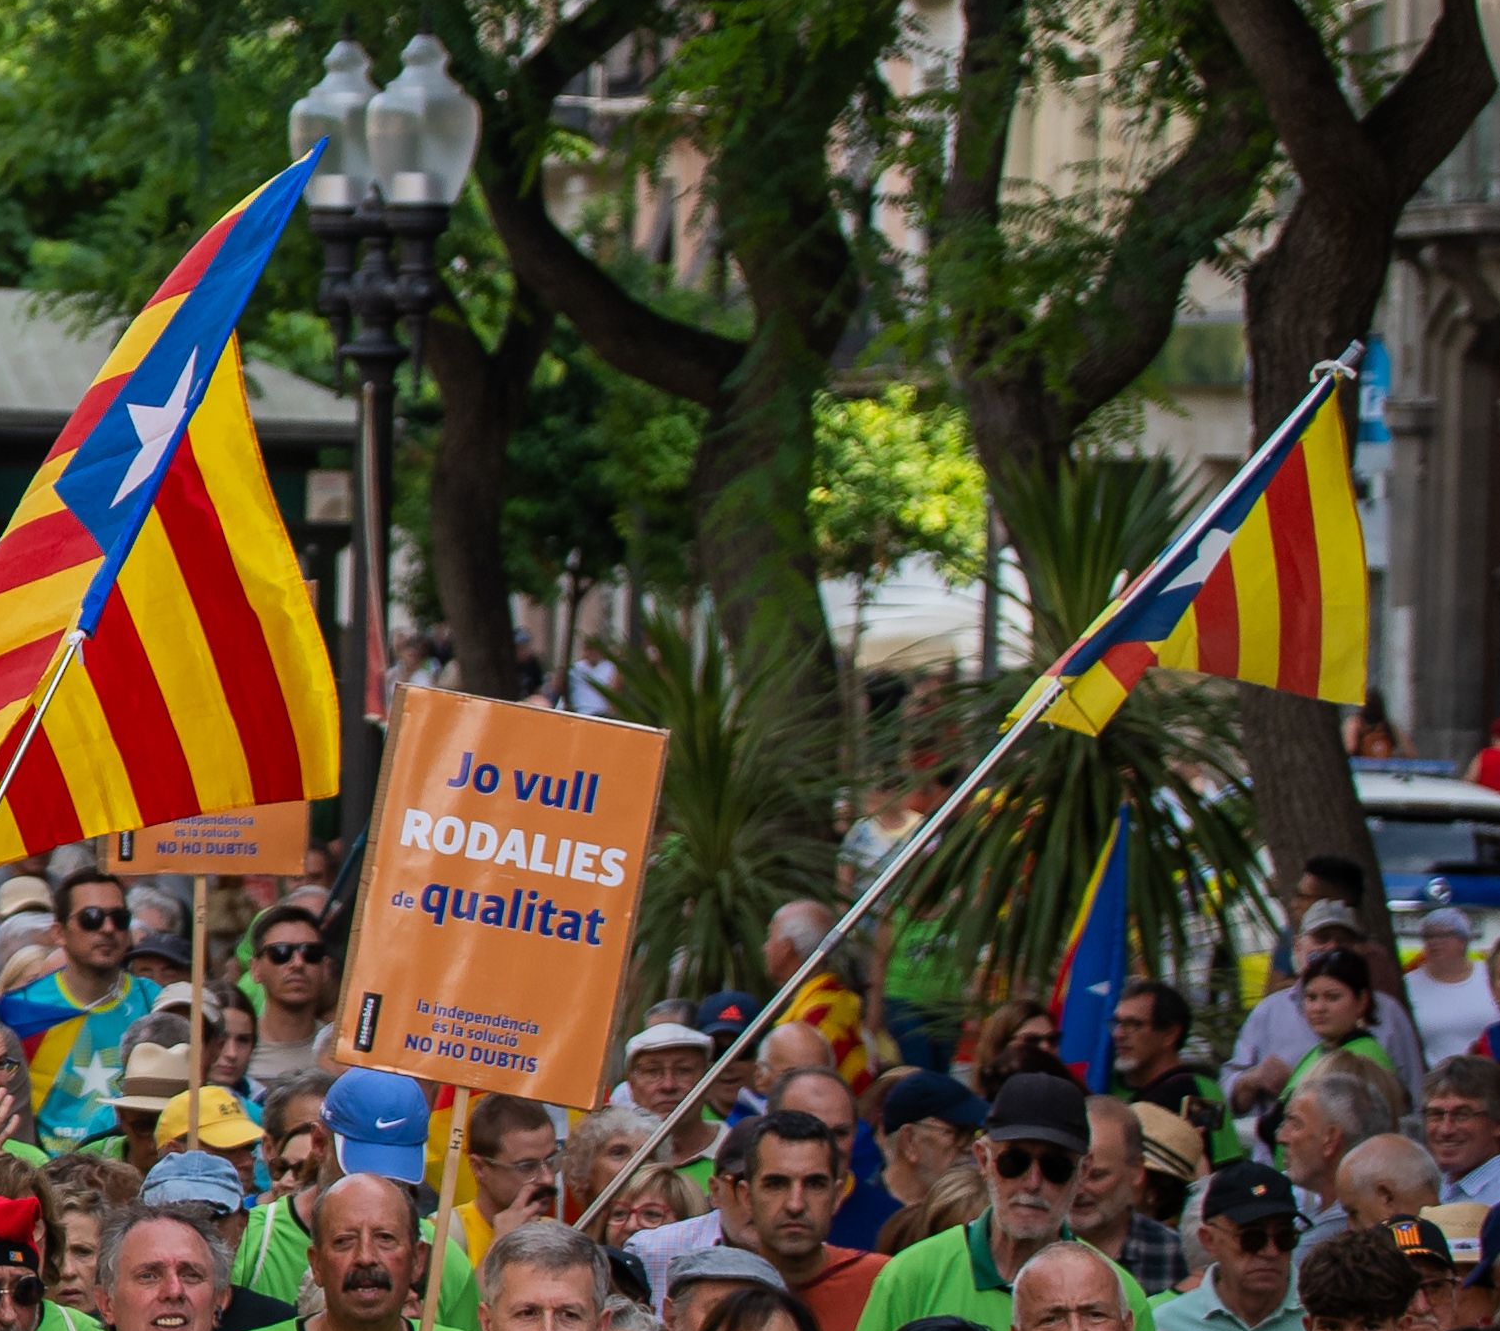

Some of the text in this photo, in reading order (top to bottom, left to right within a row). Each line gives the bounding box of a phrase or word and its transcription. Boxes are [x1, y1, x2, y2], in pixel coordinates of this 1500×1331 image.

[447, 751, 600, 815] Jo vull
[157, 842, 258, 856] NO HO DUBTIS
[400, 808, 628, 888] RODALIES
[392, 882, 606, 947] de qualitat
[431, 1019, 519, 1049] és la solució
[433, 1002, 540, 1036] independència
[404, 1033, 539, 1074] NO HO DUBTIS
